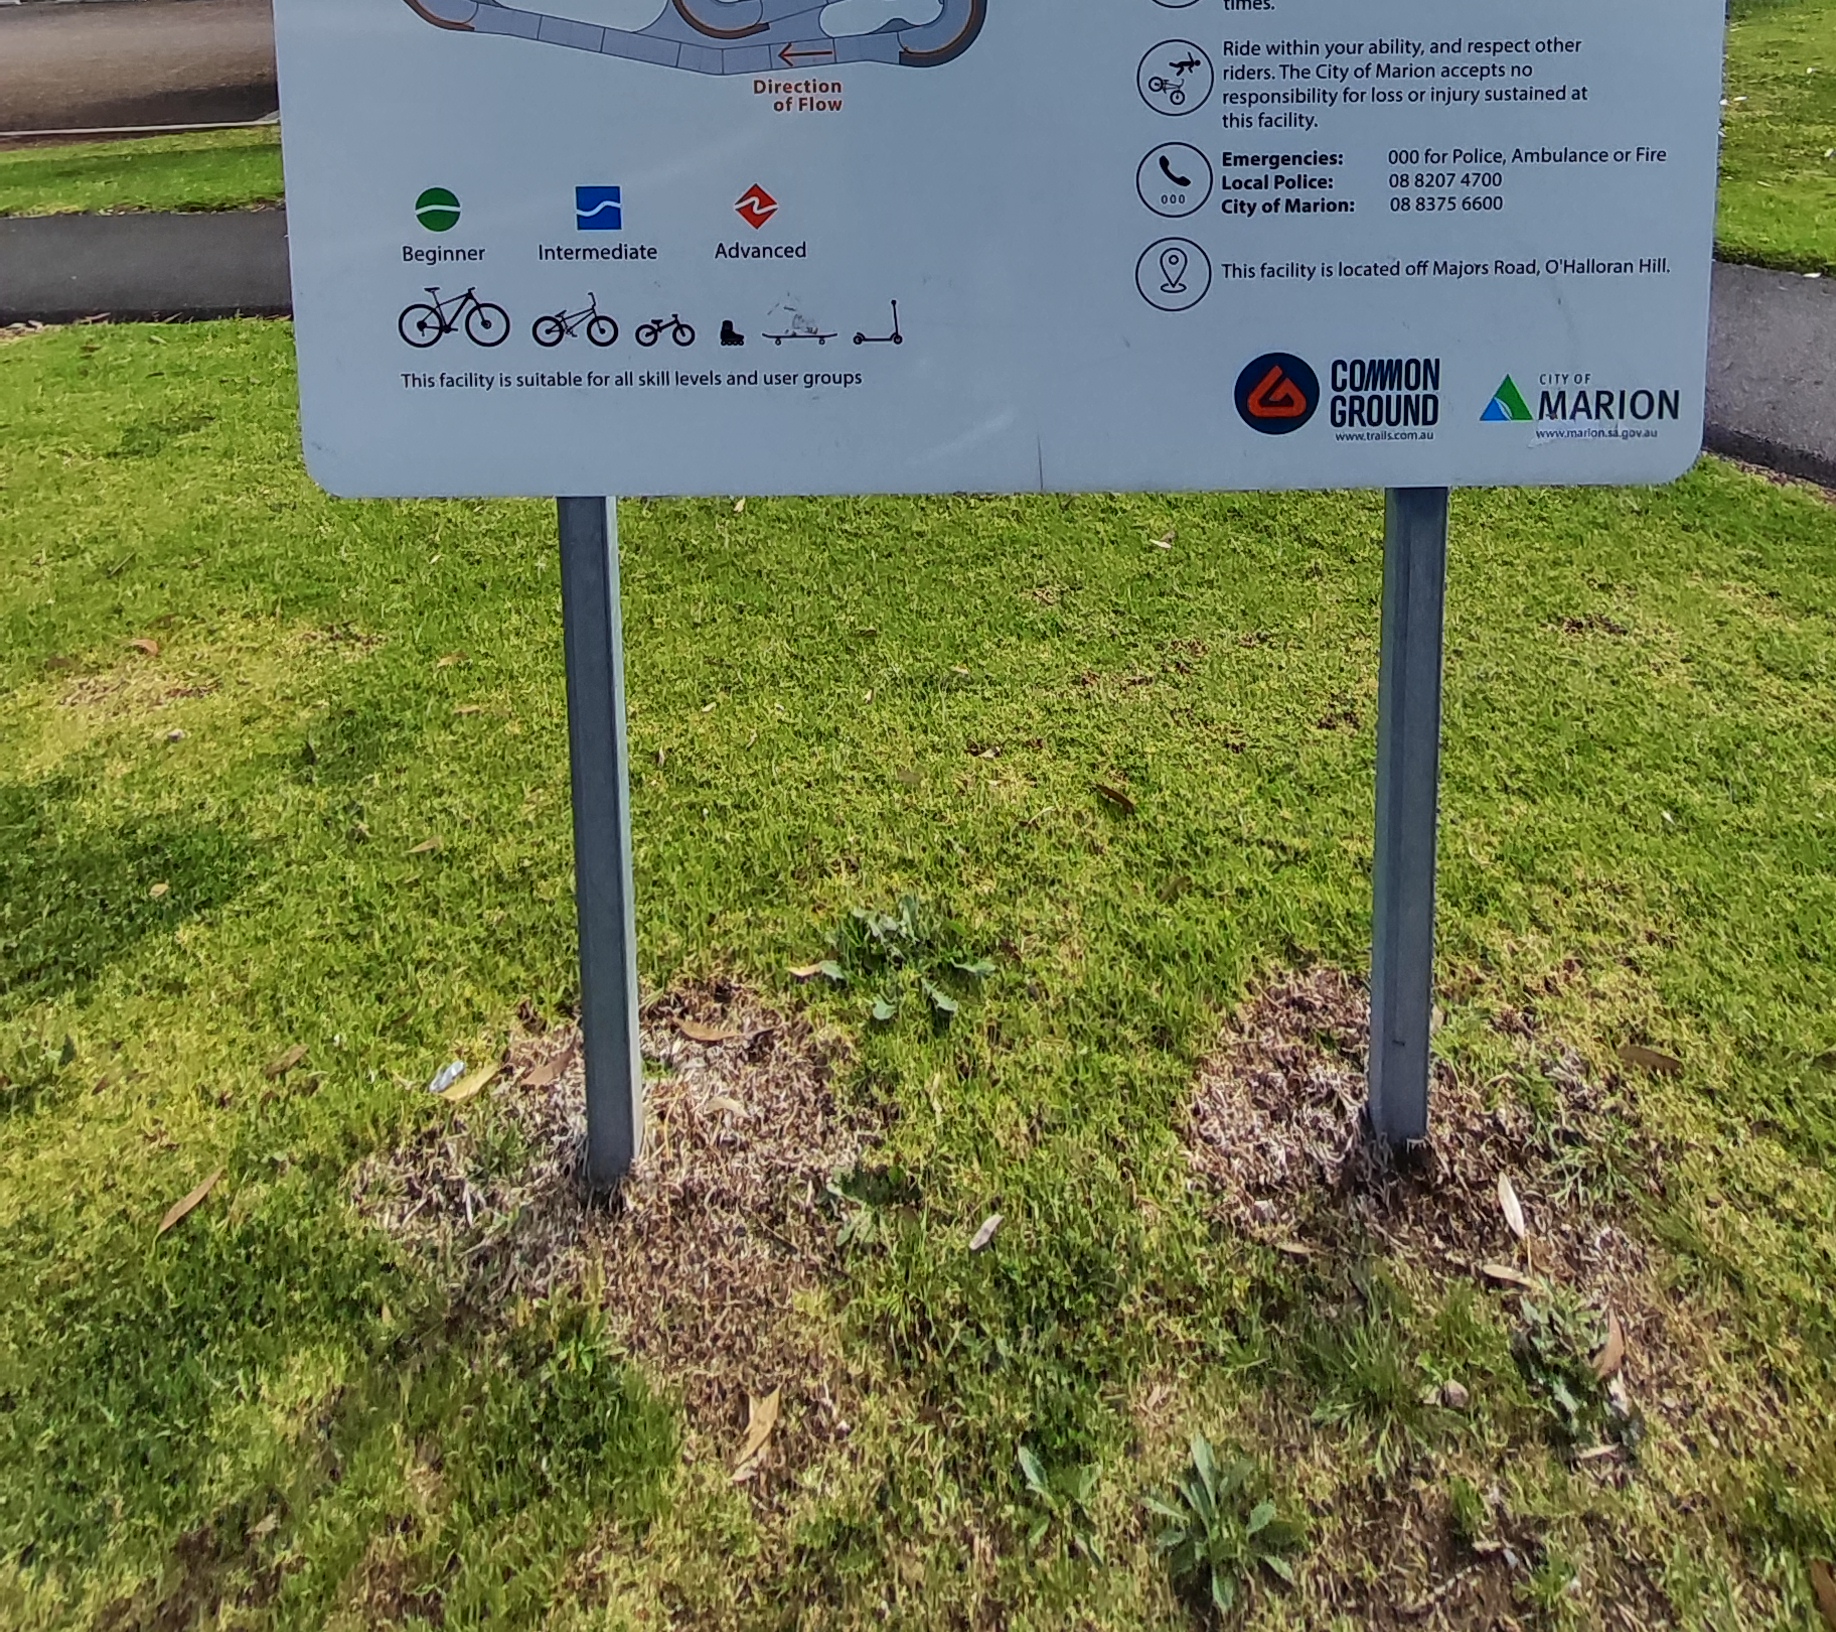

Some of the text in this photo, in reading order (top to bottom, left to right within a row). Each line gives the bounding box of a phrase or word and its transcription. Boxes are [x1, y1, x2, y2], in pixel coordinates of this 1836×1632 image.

[1224, 37, 1581, 59] Ride within your ability, and respect other
[754, 79, 841, 94] Direction
[774, 96, 842, 112] of Flow
[1222, 112, 1318, 131] this facility.
[1223, 150, 1342, 169] Emergencies:
[1389, 146, 1666, 165] 000 for Police, Ambulance or Fire
[1222, 174, 1332, 190] Local Police:
[1389, 171, 1502, 188] 08 8207 4700
[1161, 193, 1185, 204] 000
[1222, 197, 1354, 217] City of Marion:
[1390, 195, 1502, 211] 08 8375 6600
[403, 246, 485, 265] Beginner
[539, 243, 657, 260] Intermediate
[715, 242, 806, 258] Advanced
[1222, 257, 1670, 281] This facility is located off Majors Road, O'Halloran Hill.
[401, 370, 862, 390] This facility is suitable for all skill levels and user groups
[1332, 358, 1440, 392] COMMON
[1540, 373, 1590, 385] CITY OF
[1331, 394, 1438, 427] GROUND
[1538, 390, 1679, 420] MARION
[1336, 430, 1433, 441] www.trails.com.au
[1536, 426, 1657, 440] www.marion.sa.gov.au
